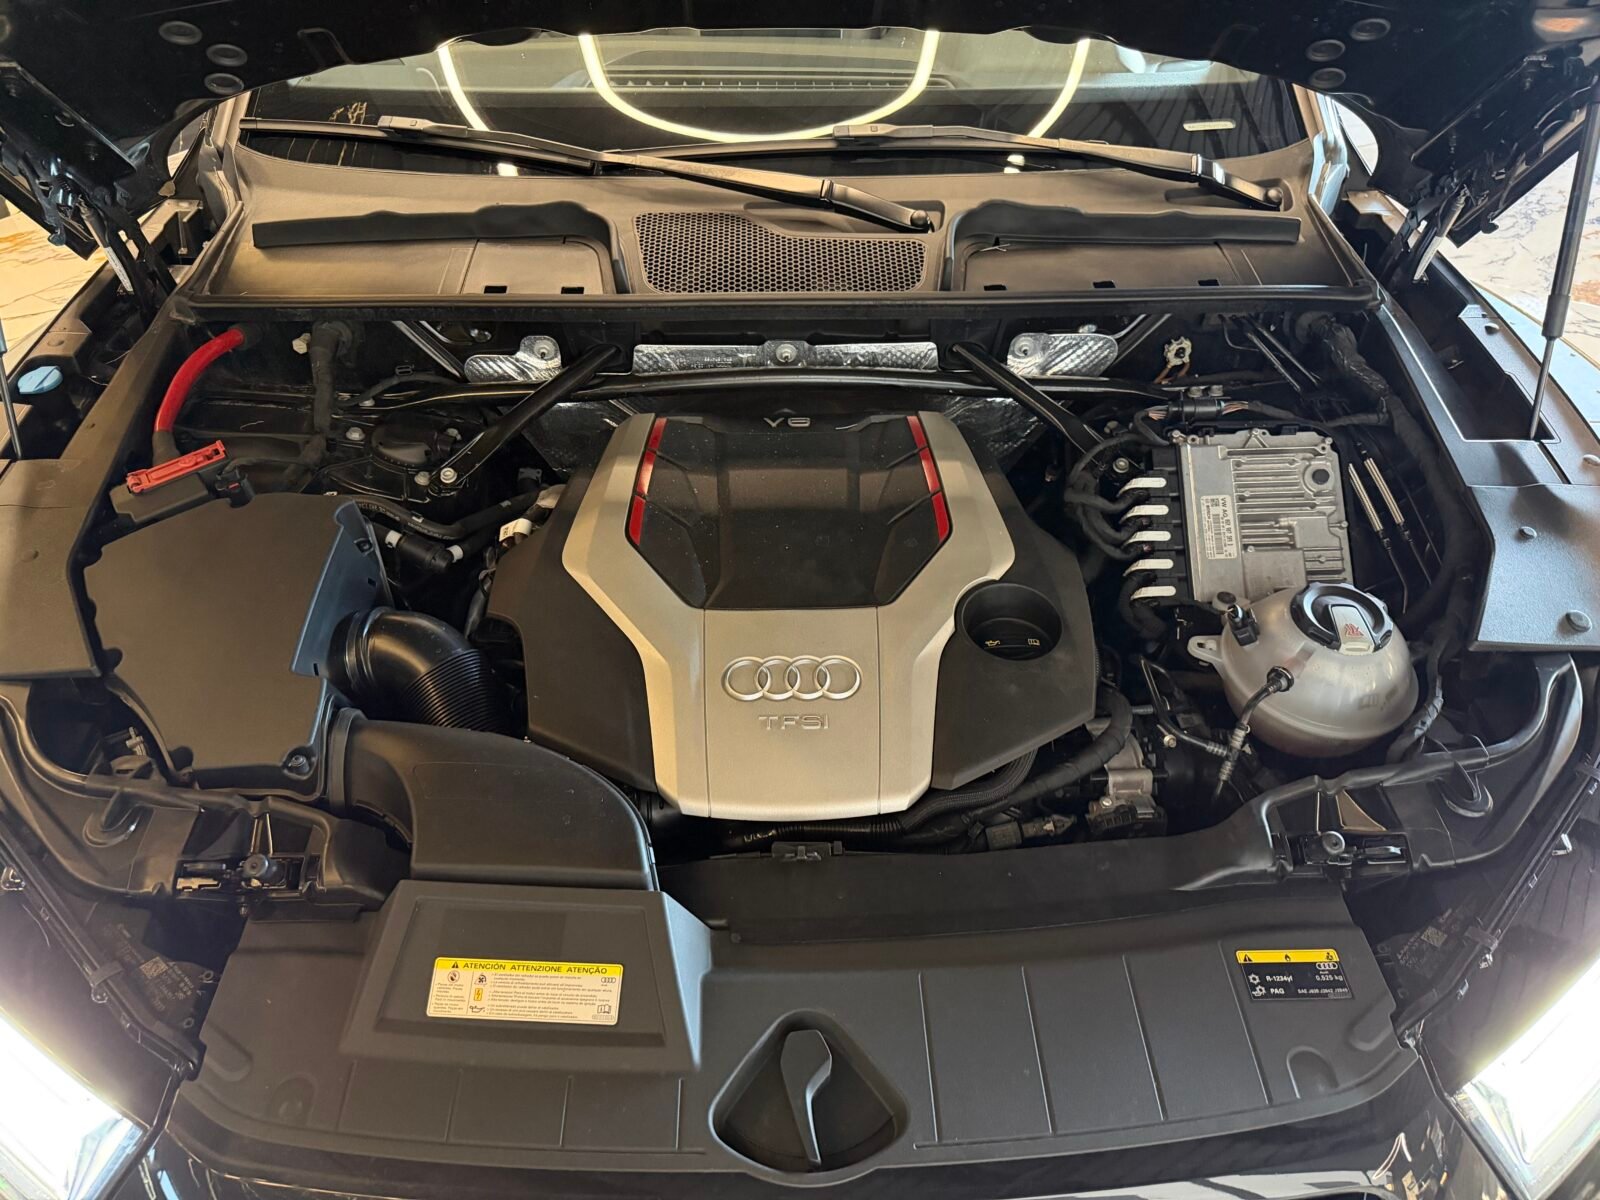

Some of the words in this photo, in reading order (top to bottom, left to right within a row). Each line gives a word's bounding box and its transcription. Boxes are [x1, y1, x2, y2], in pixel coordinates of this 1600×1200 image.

[763, 417, 811, 428] V6
[758, 714, 829, 731] TFSI
[463, 961, 507, 971] ATENCIÓN
[510, 964, 562, 973] ATTENZIONE
[566, 966, 608, 975] ATENÇÃO
